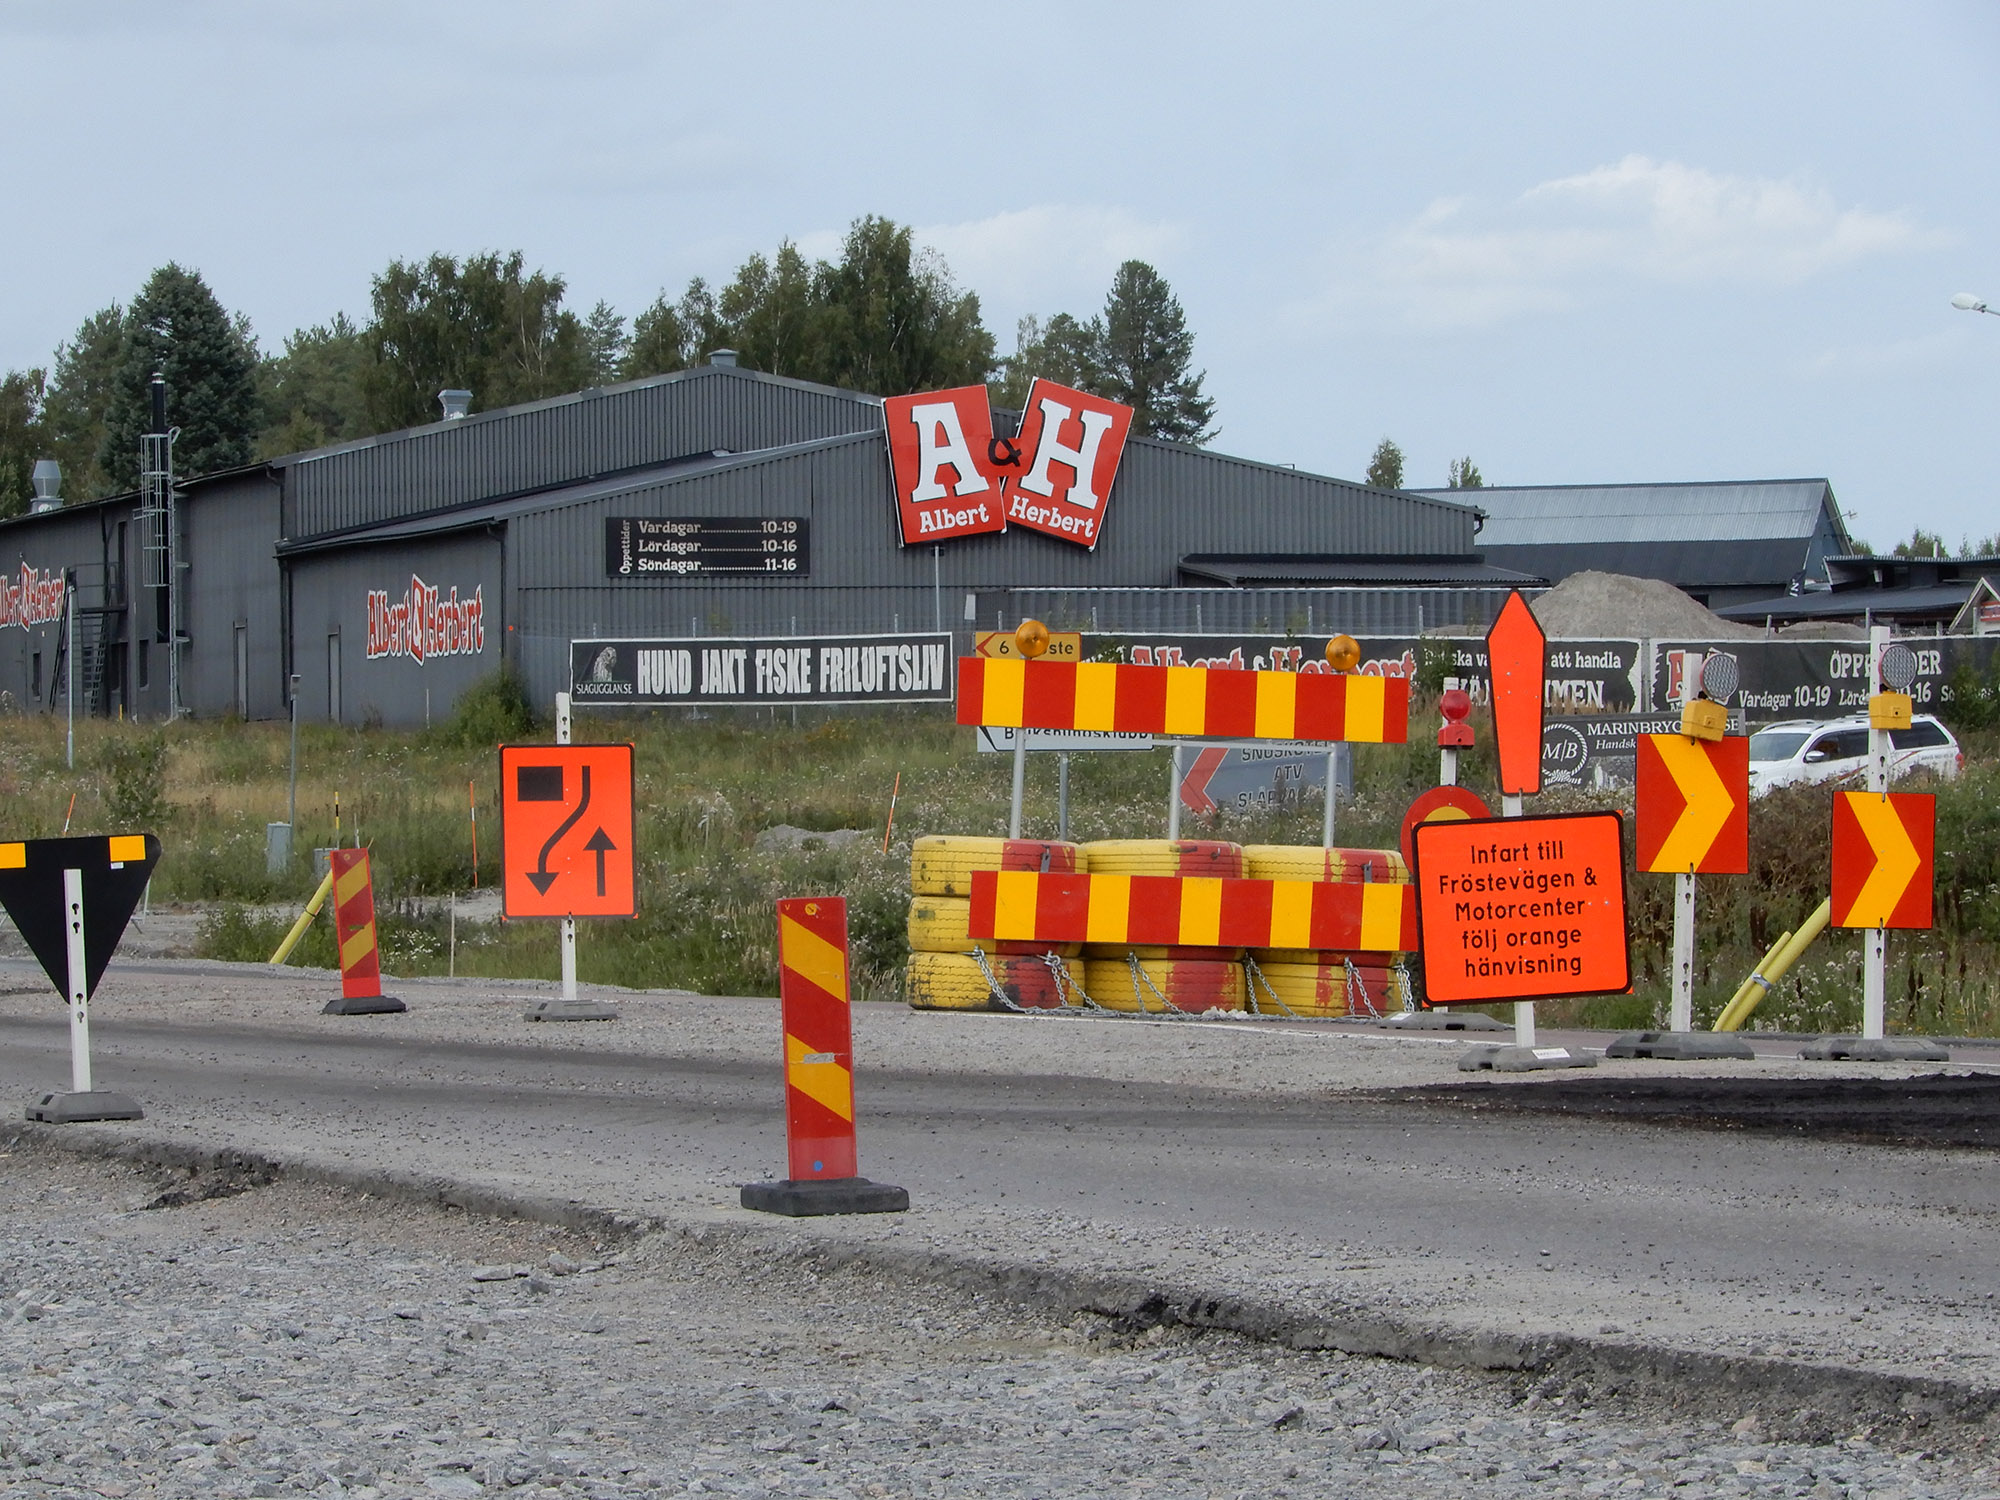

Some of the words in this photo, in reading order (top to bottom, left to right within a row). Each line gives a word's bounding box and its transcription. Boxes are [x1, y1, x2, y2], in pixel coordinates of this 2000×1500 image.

[911, 402, 990, 503] A
[988, 438, 1022, 467] &
[1018, 397, 1113, 510] H
[919, 503, 990, 534] Albert
[1008, 495, 1095, 538] Herbert
[638, 521, 701, 537] Vardagar
[761, 521, 797, 533] 10-19
[638, 539, 701, 555] Lördagar
[761, 539, 797, 552] 10-16
[638, 558, 701, 574] Söndagar
[764, 558, 797, 571] 11-16
[367, 589, 411, 660] Albert
[425, 583, 484, 657] Herbert
[999, 641, 1009, 654] 6
[637, 649, 691, 695] HUND
[700, 648, 747, 694] JAKT
[755, 647, 811, 694] FISKE
[820, 644, 944, 693] FRILUFTSLIV
[1550, 652, 1572, 669] att
[1575, 651, 1622, 669] handla
[1739, 690, 1791, 712] Vardagar
[1794, 685, 1831, 707] 10-19
[1595, 738, 1637, 750] Handsk
[1471, 844, 1529, 864] Infart
[1538, 840, 1564, 860] till
[1439, 870, 1575, 895] Fröstevägen
[1584, 867, 1597, 886] &
[1455, 898, 1585, 921] Motorcenter
[1462, 929, 1497, 953] följ
[1506, 928, 1582, 949] orange
[1465, 953, 1581, 977] hänvisning
